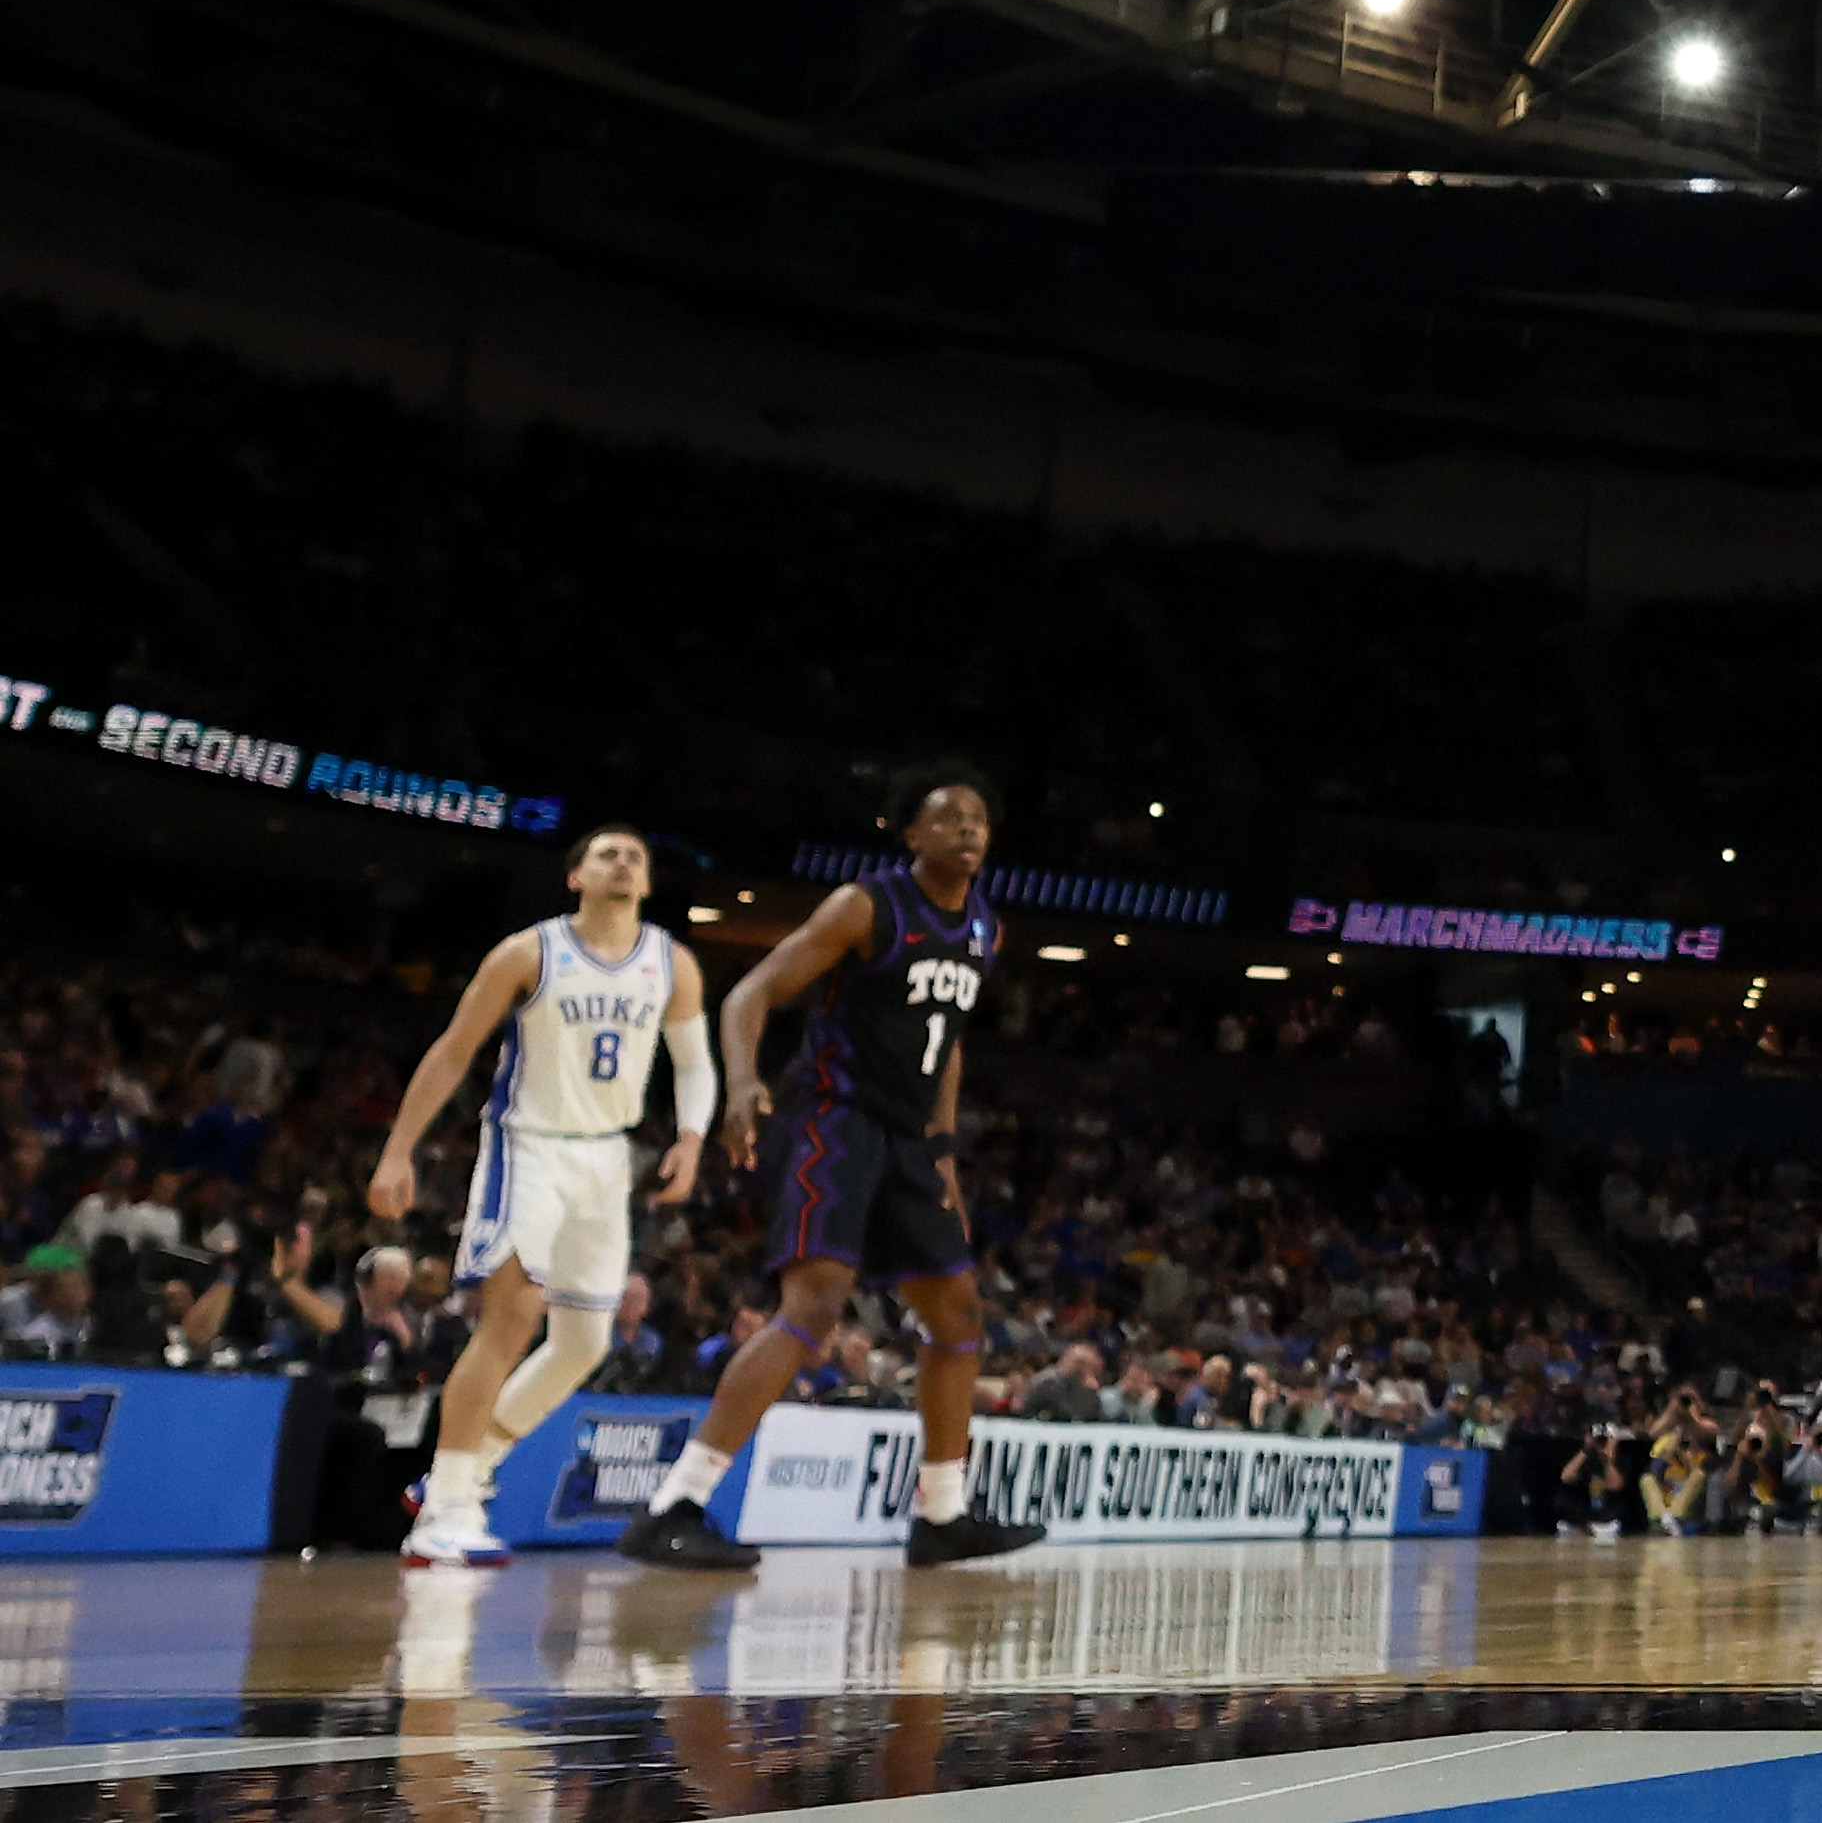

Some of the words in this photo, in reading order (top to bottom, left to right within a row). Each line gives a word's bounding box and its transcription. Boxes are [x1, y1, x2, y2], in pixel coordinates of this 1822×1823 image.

[100, 703, 301, 789] SECOND
[307, 751, 506, 830] ROUNDS
[559, 993, 656, 1029] DUKE
[906, 957, 981, 1012] TCU
[591, 1030, 620, 1081] 8
[920, 1011, 946, 1077] 1
[1100, 1443, 1241, 1520] SOUTHERN
[1248, 1450, 1392, 1521] CONFERENCE
